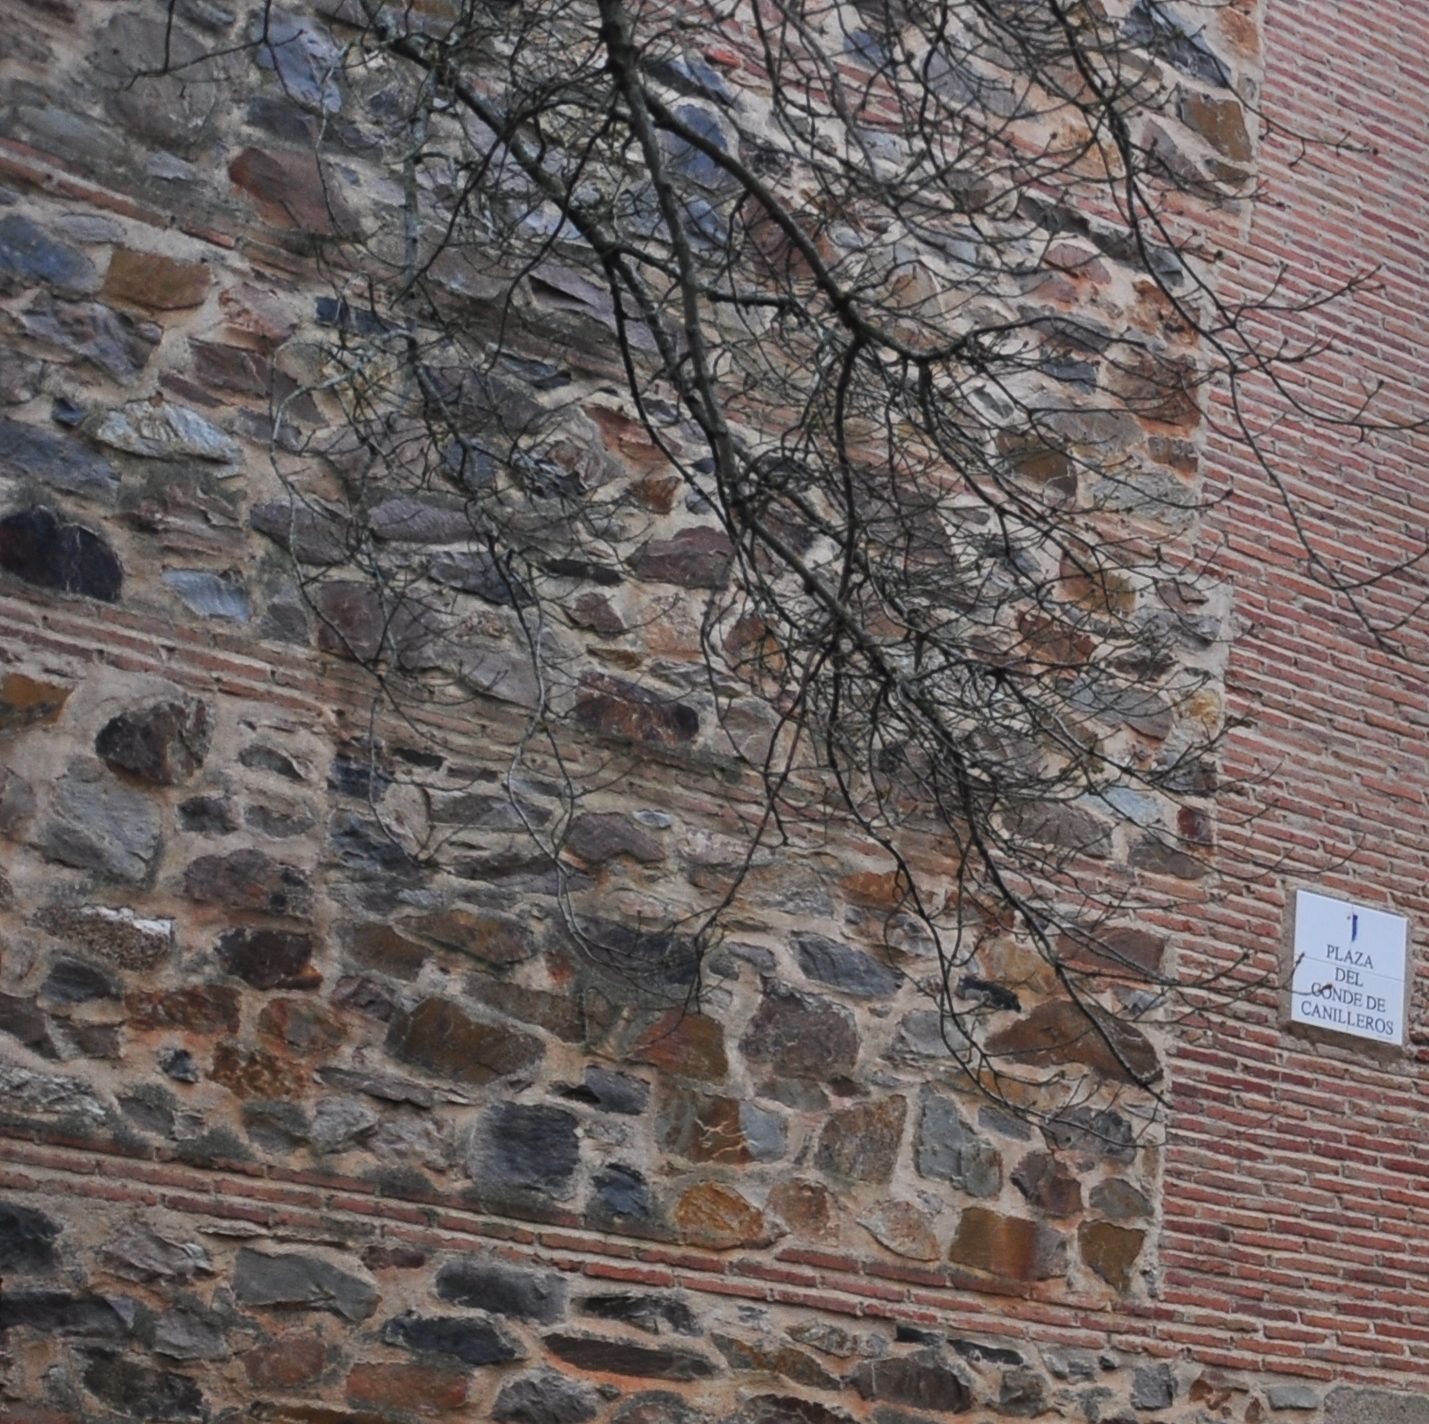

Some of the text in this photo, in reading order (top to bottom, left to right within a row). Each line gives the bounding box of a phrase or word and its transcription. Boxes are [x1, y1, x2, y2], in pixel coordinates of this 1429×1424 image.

[1326, 944, 1374, 969] PLAZA
[1335, 967, 1364, 987] DEL
[1312, 982, 1386, 1013] CONDE DE
[1301, 1000, 1394, 1036] CANILLEROS
